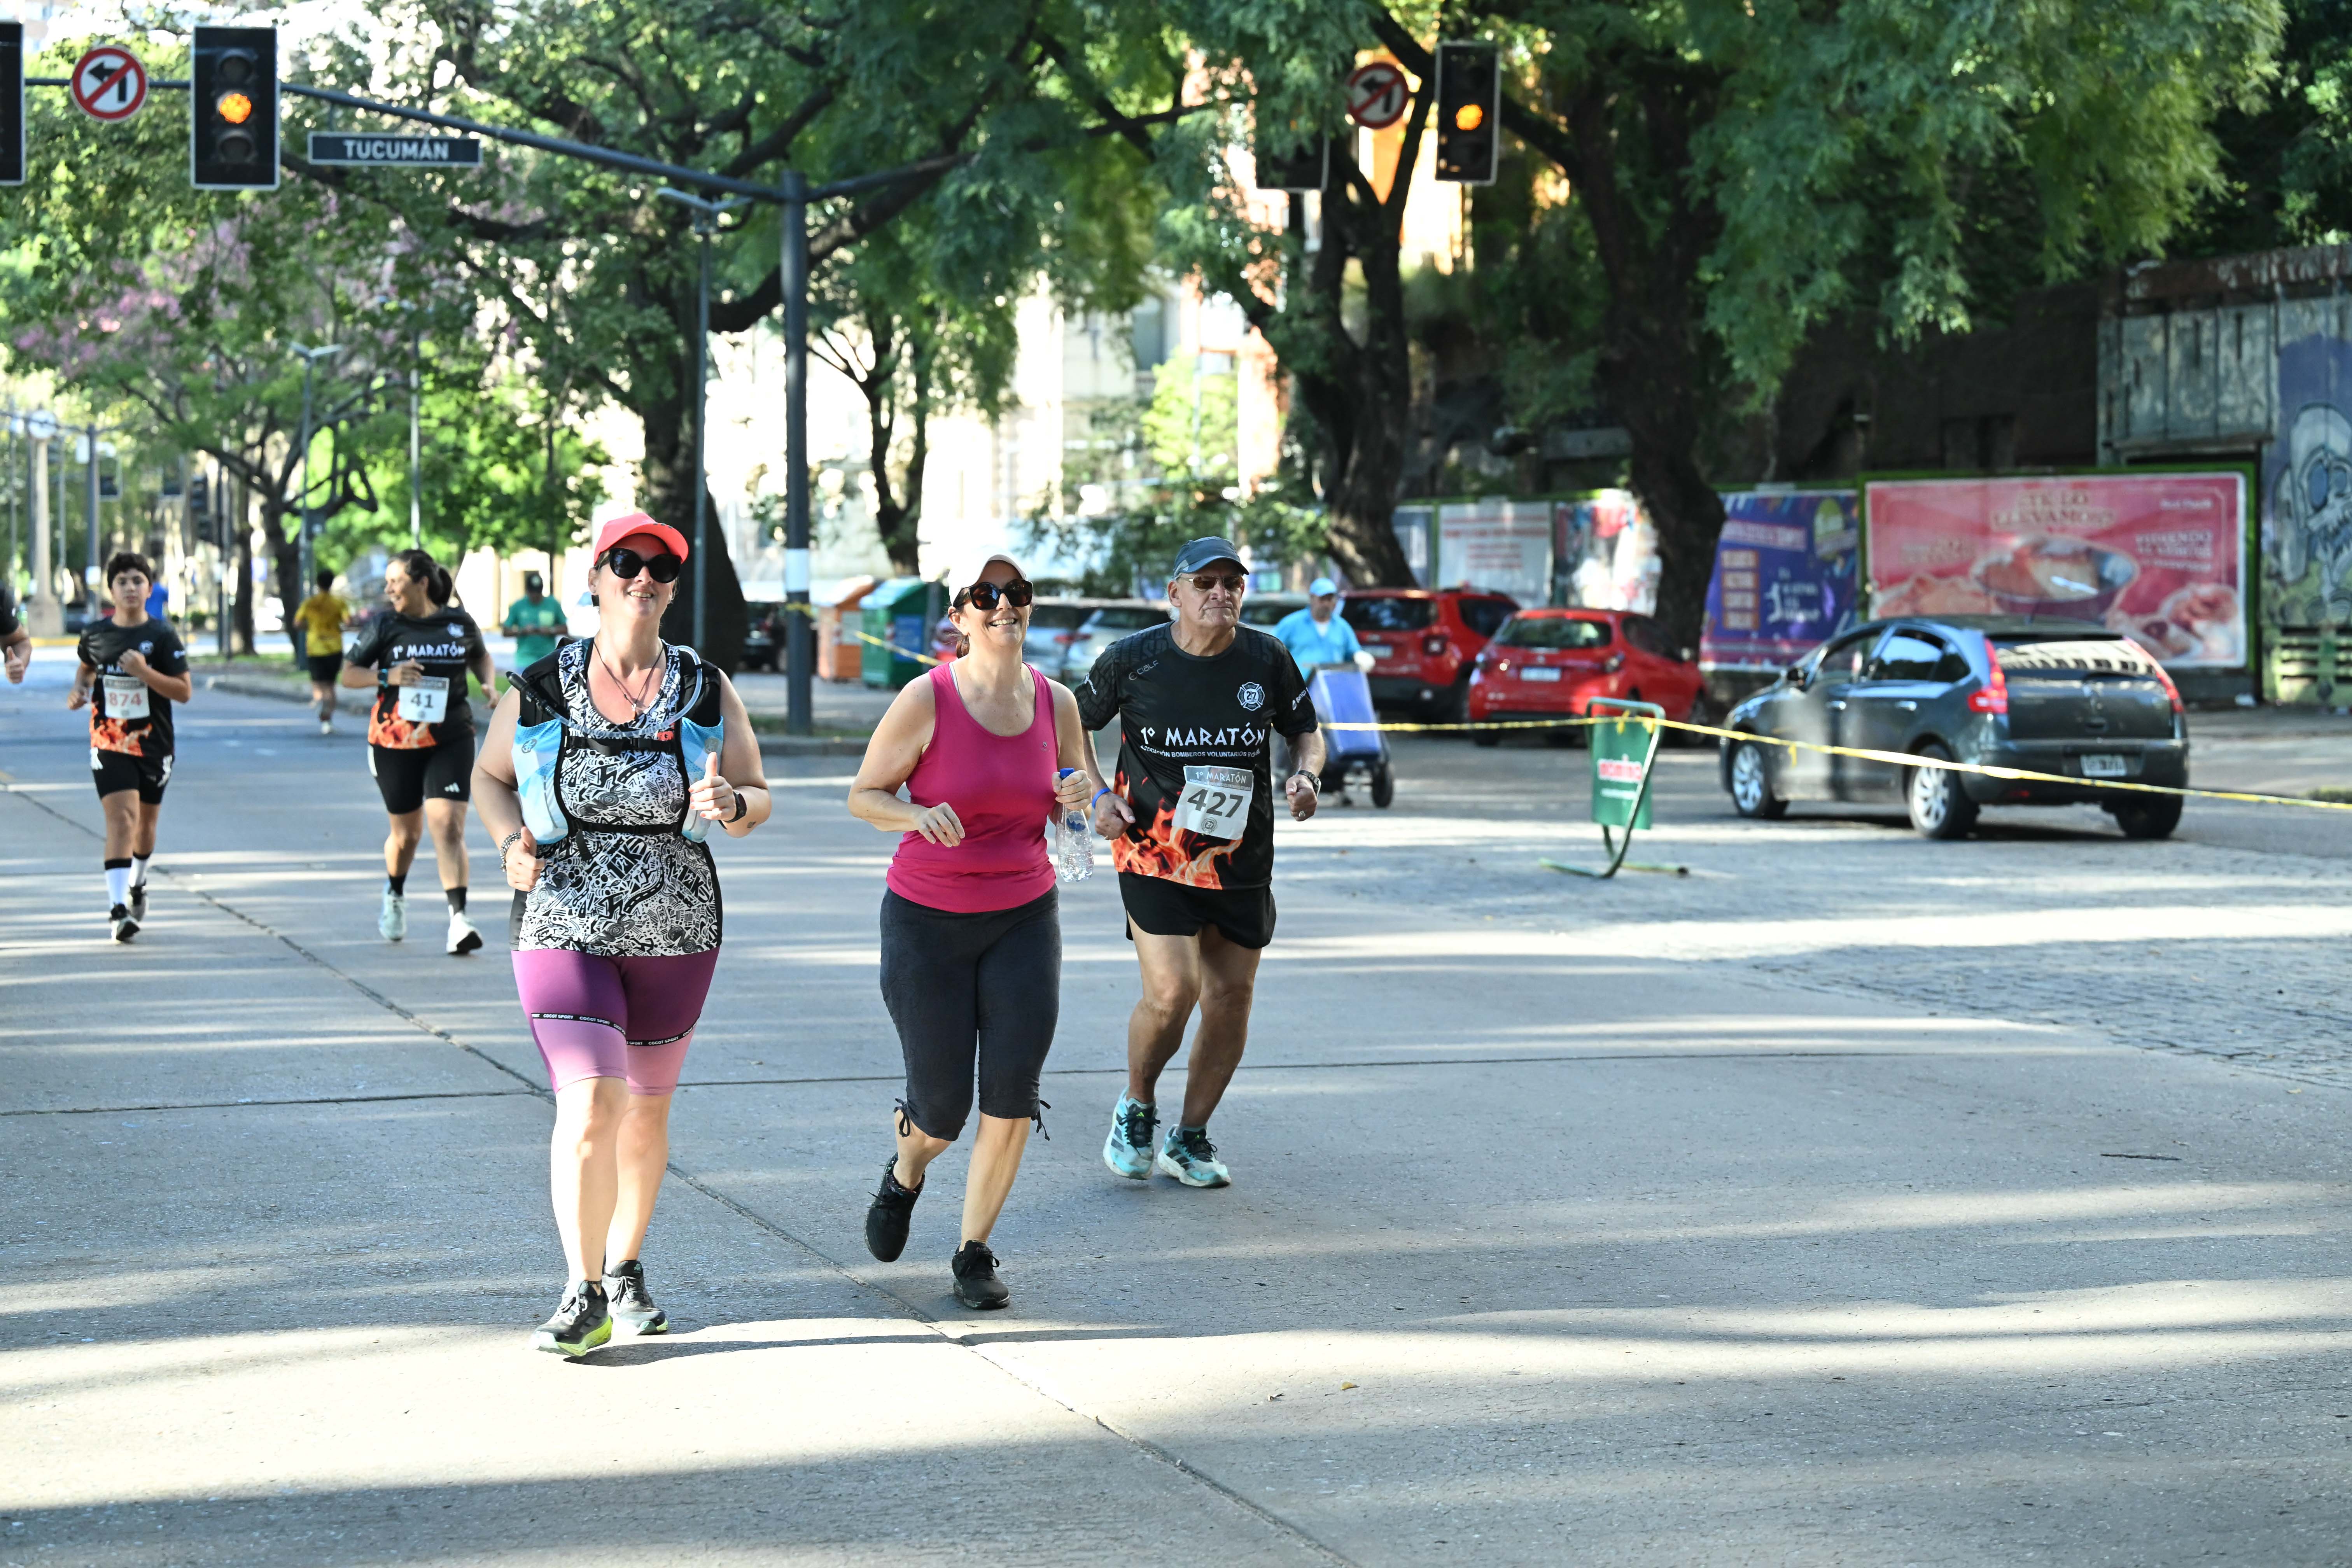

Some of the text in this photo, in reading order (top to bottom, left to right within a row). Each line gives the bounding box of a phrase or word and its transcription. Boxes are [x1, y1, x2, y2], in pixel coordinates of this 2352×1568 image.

[343, 135, 449, 160] TUCUMÁN
[109, 692, 142, 706] 874
[410, 693, 433, 709] 41
[1165, 722, 1265, 746] MARATÓN
[1206, 771, 1246, 784] MARATÓN
[1187, 789, 1243, 818] 427
